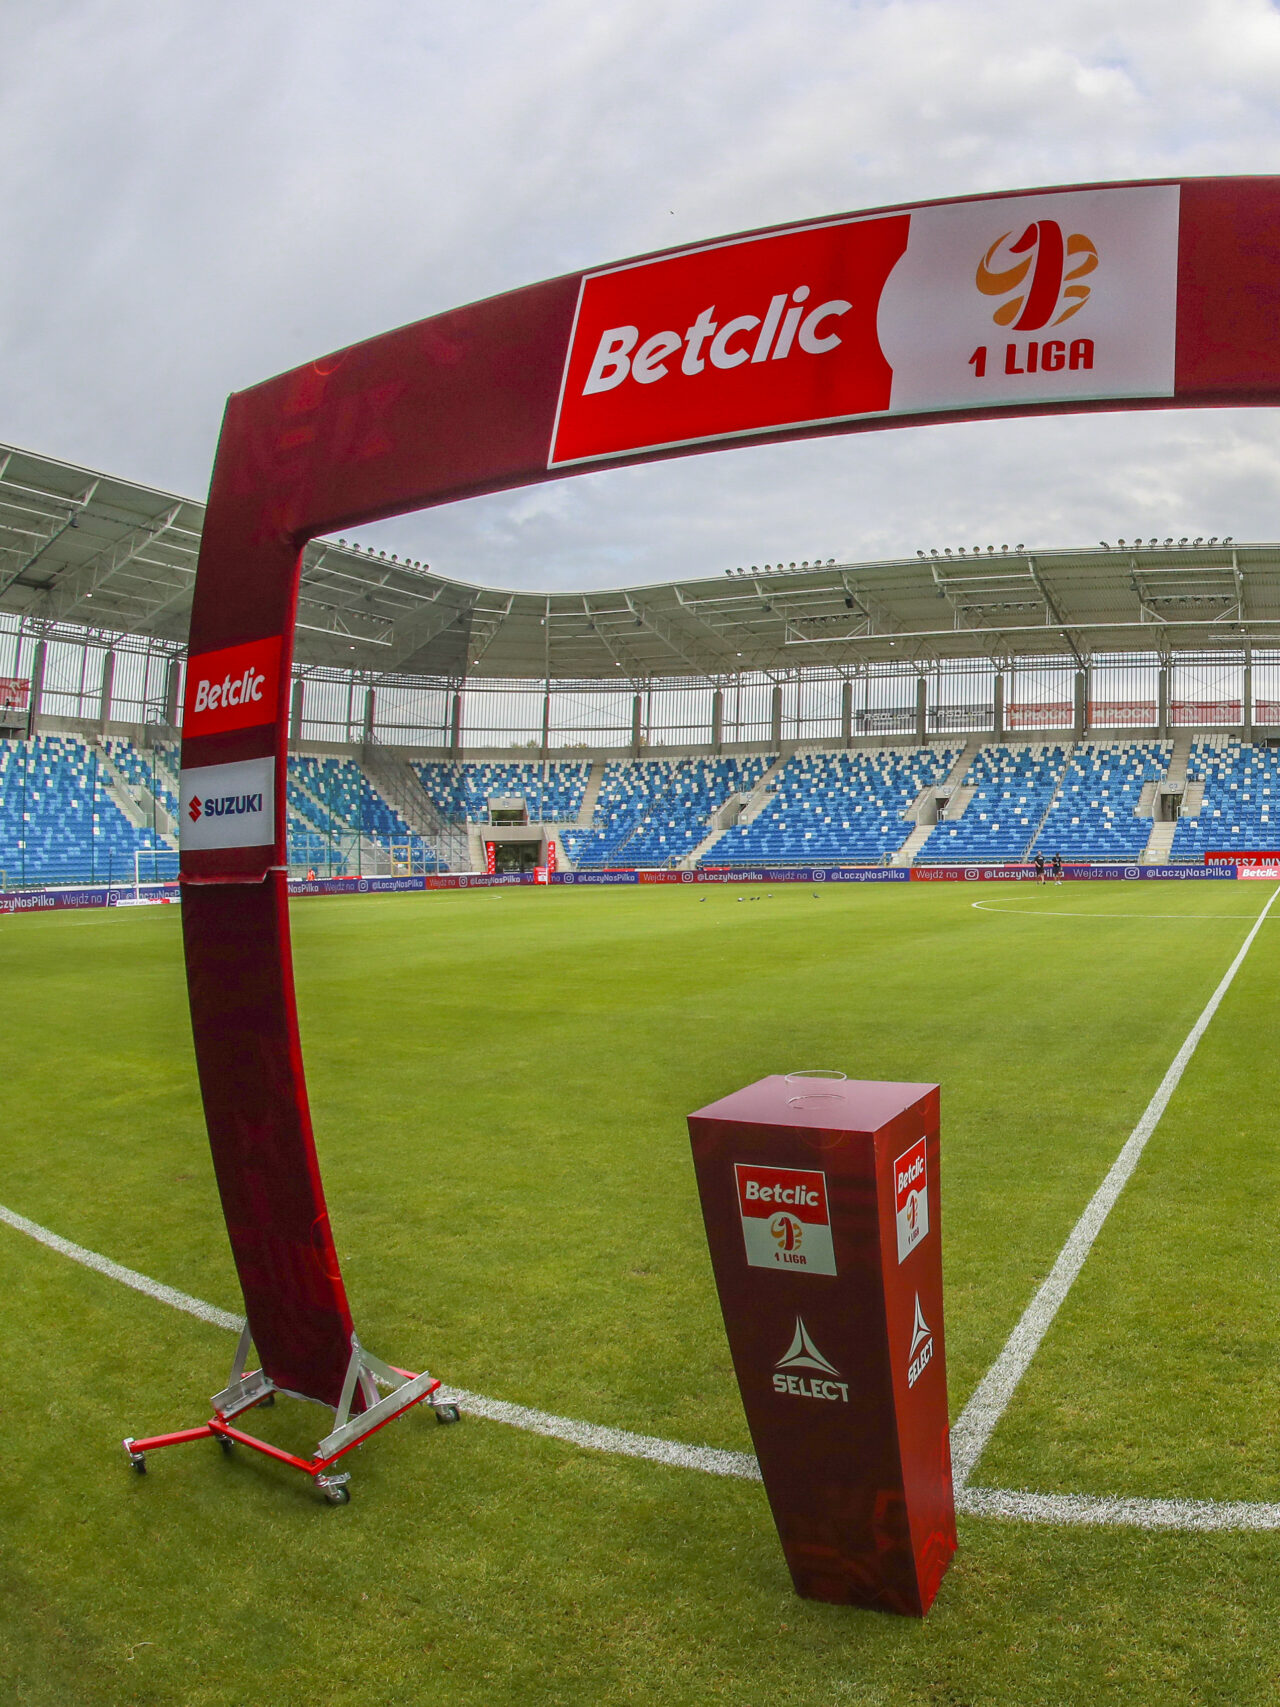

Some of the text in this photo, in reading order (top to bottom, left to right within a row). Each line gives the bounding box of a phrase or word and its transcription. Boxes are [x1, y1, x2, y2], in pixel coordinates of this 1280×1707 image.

[581, 284, 853, 397] Betclic
[967, 338, 1096, 378] 1 LIGA
[194, 666, 266, 713] Betclic
[204, 793, 263, 817] SUZUKI
[1146, 868, 1232, 879] @LaczyNasPilka
[1242, 868, 1278, 878] Betclic
[897, 1155, 924, 1194] Betclic
[745, 1180, 819, 1207] Betclic
[911, 1226, 920, 1243] LIGA
[774, 1252, 807, 1265] 1 LIGA
[907, 1336, 933, 1389] SELECT
[772, 1373, 849, 1403] SELECT
